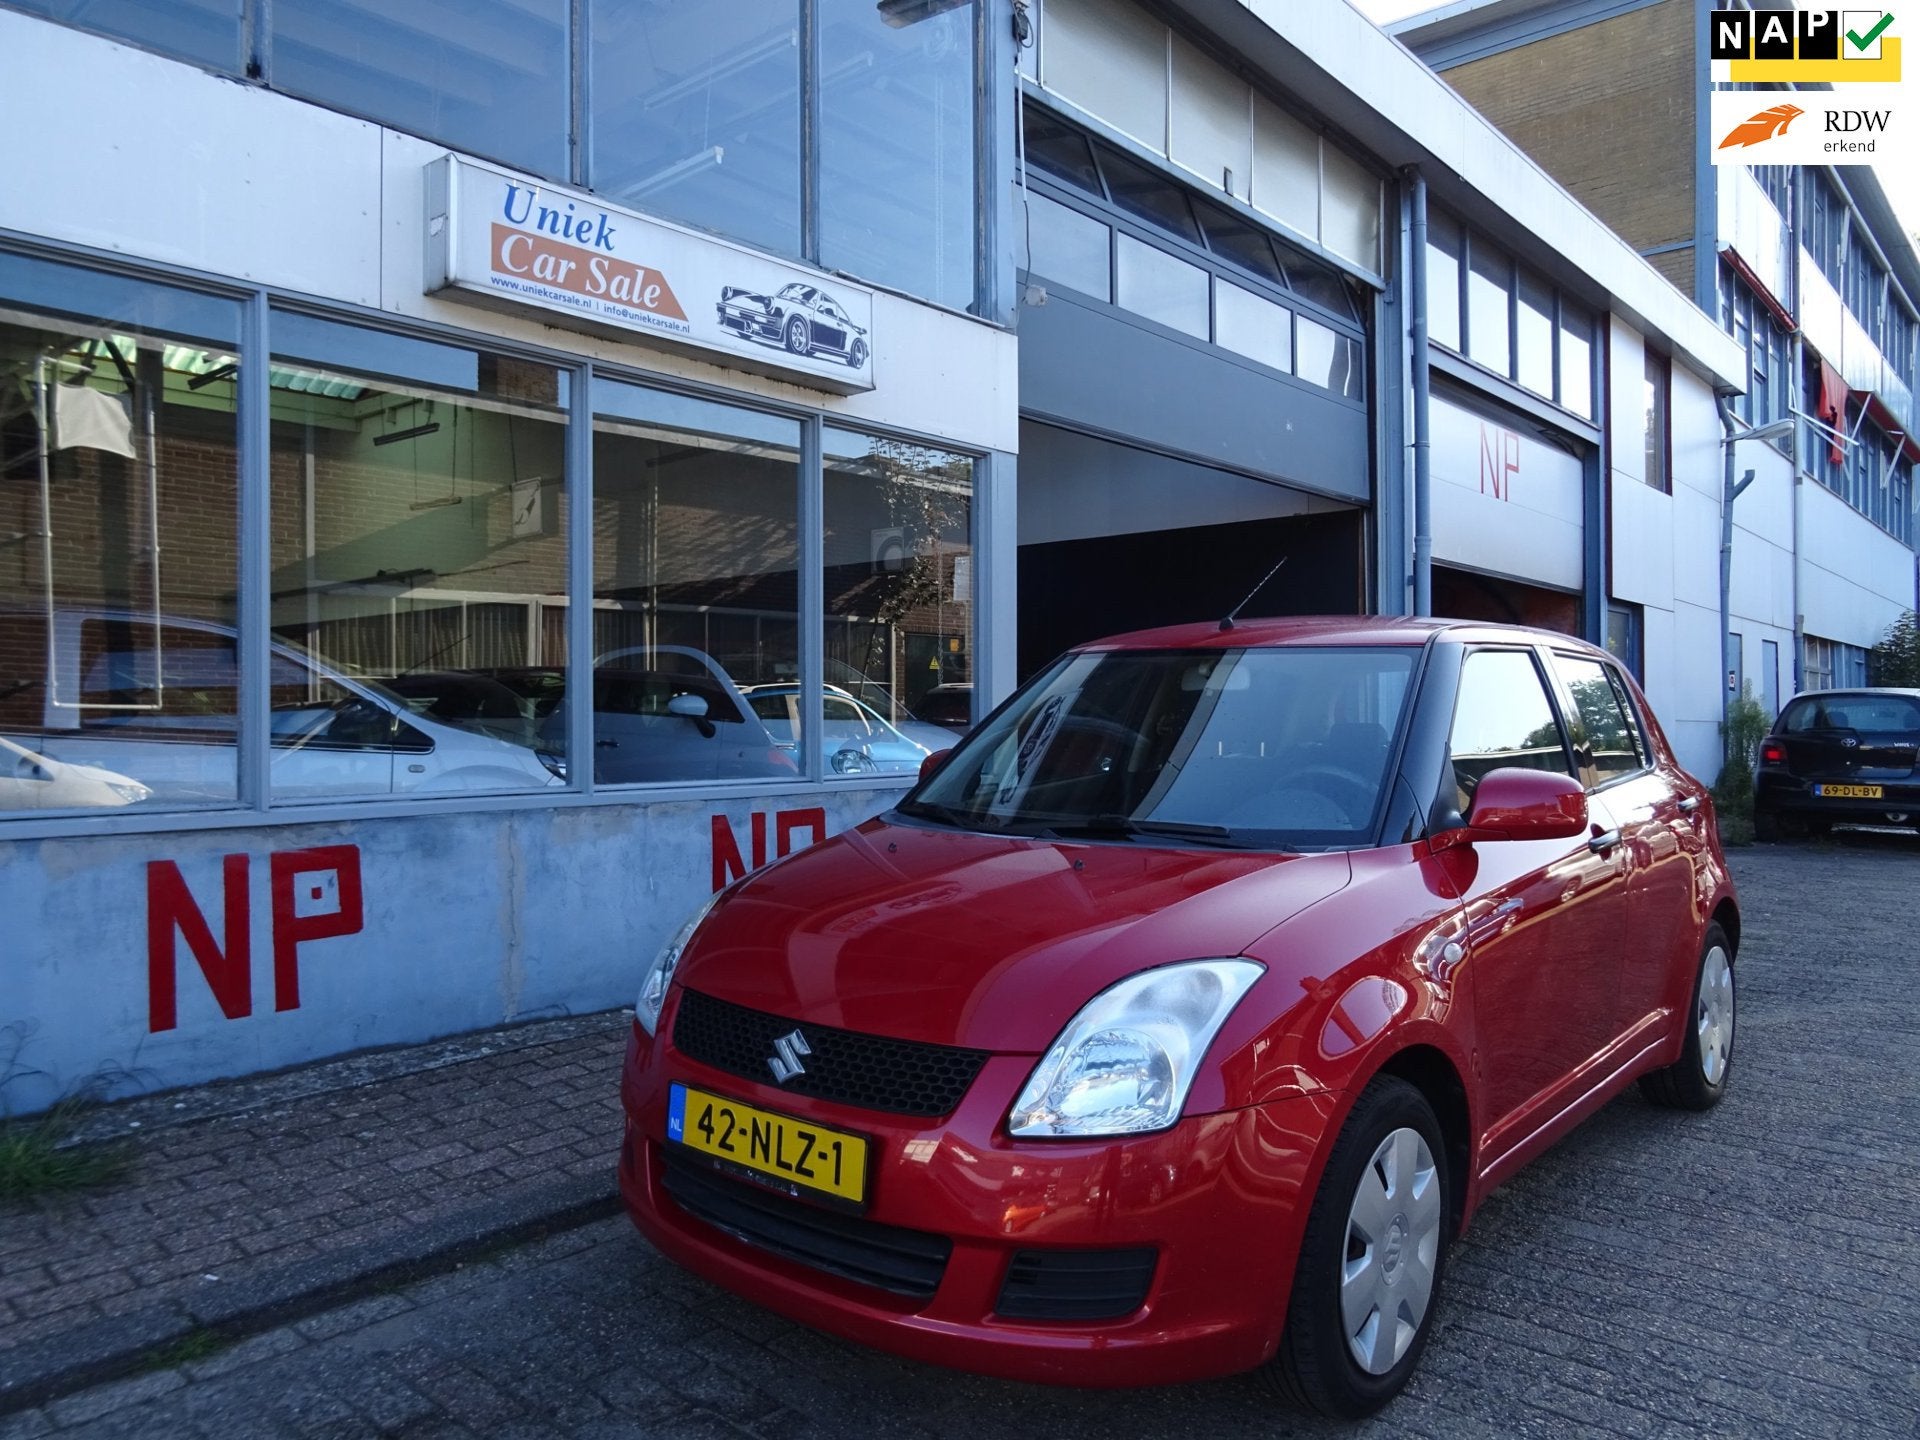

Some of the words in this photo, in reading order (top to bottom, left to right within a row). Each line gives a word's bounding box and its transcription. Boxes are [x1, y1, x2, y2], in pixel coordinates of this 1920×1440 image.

[503, 183, 617, 251] Uniek
[491, 276, 592, 309] www.uniekcarsale.nl
[603, 304, 690, 334] info@uniekcarsale.nl
[501, 234, 576, 284] Car
[585, 257, 661, 309] Sale
[1480, 421, 1520, 502] NP
[1823, 785, 1879, 797] 69-DL-BV
[147, 843, 364, 1034] NP
[670, 1116, 682, 1132] NL
[697, 1103, 842, 1187] 42-NLZ-1
